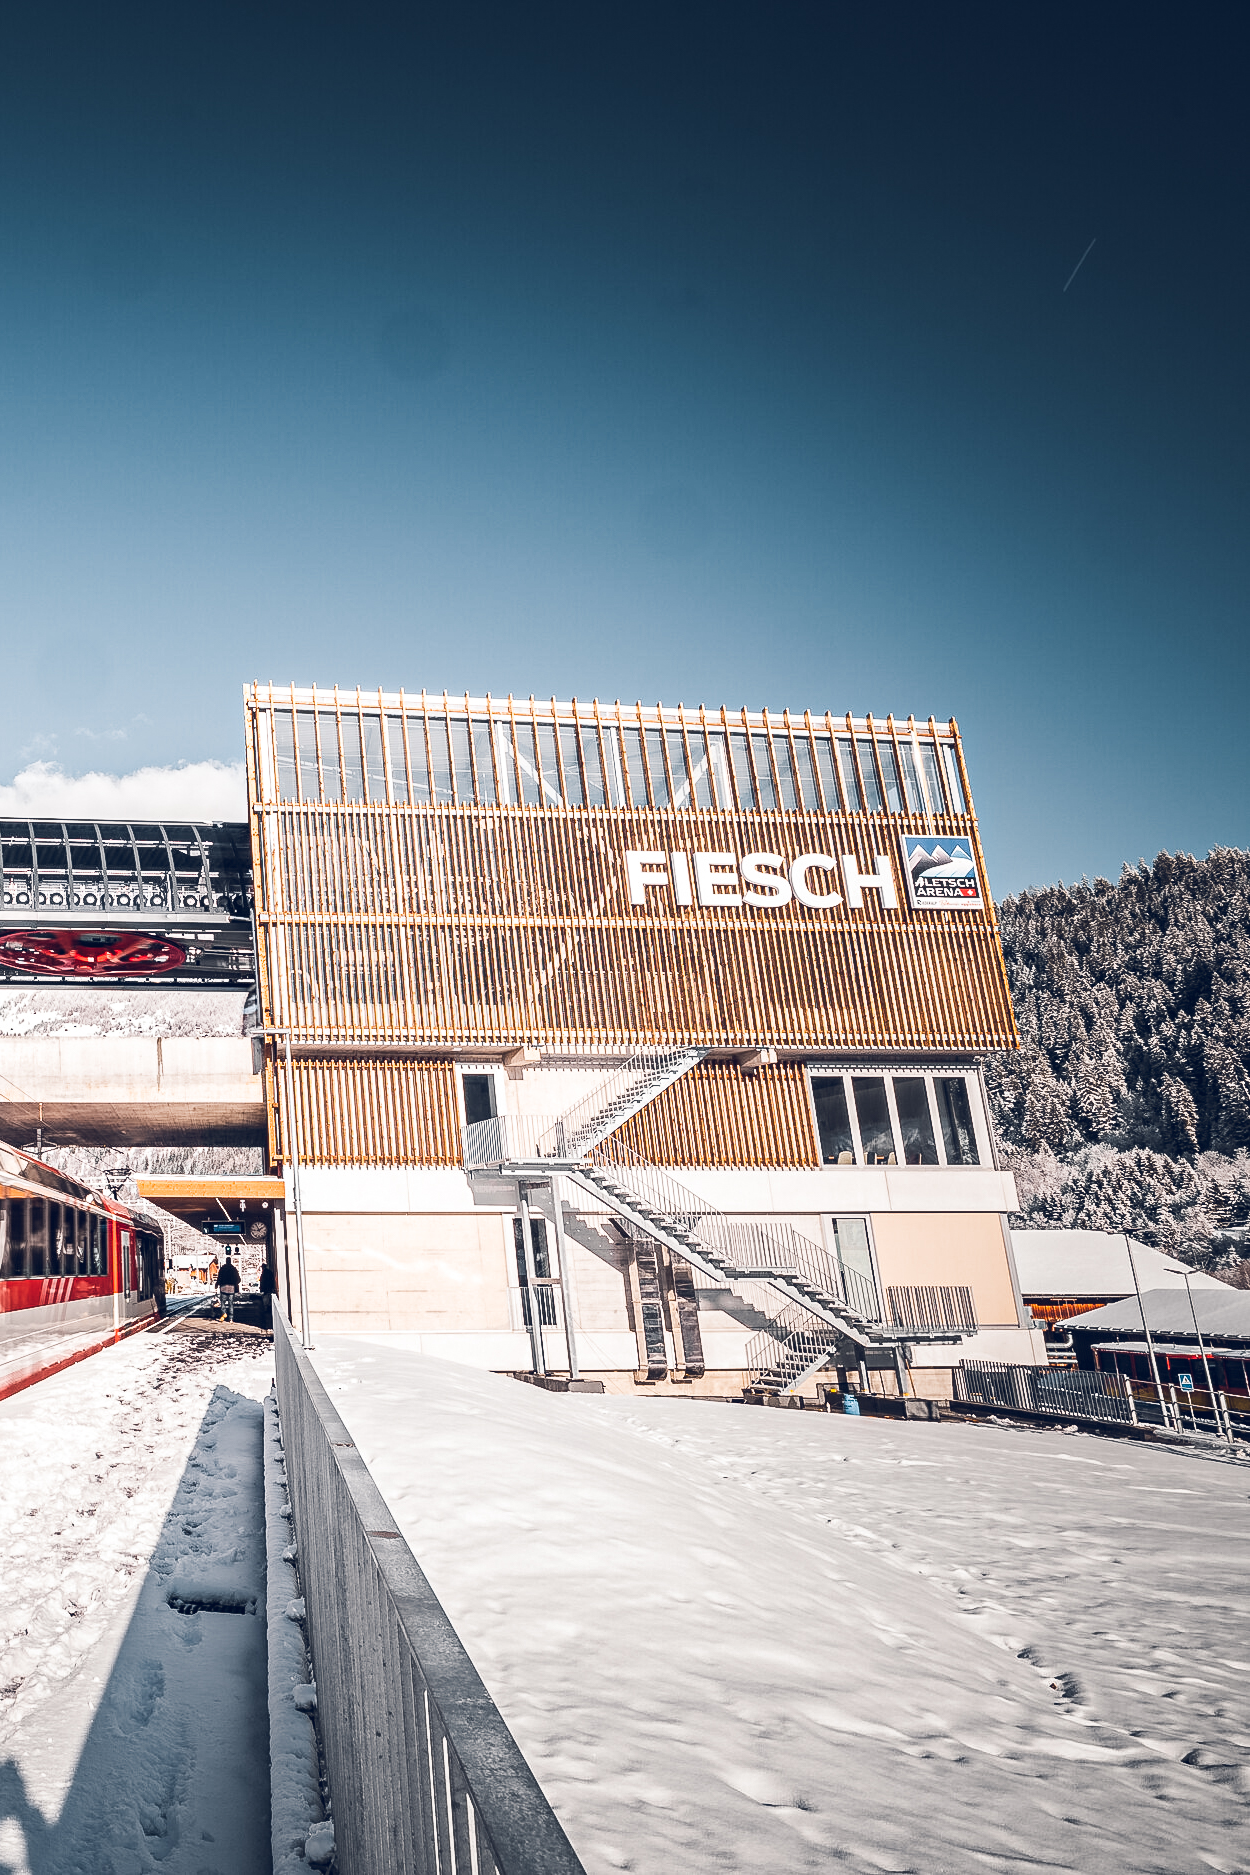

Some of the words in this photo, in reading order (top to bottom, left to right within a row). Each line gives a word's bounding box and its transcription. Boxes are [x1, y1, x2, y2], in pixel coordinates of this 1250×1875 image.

[625, 850, 899, 909] FIESCH
[915, 876, 975, 888] ALETSCH
[917, 887, 963, 897] ARENA
